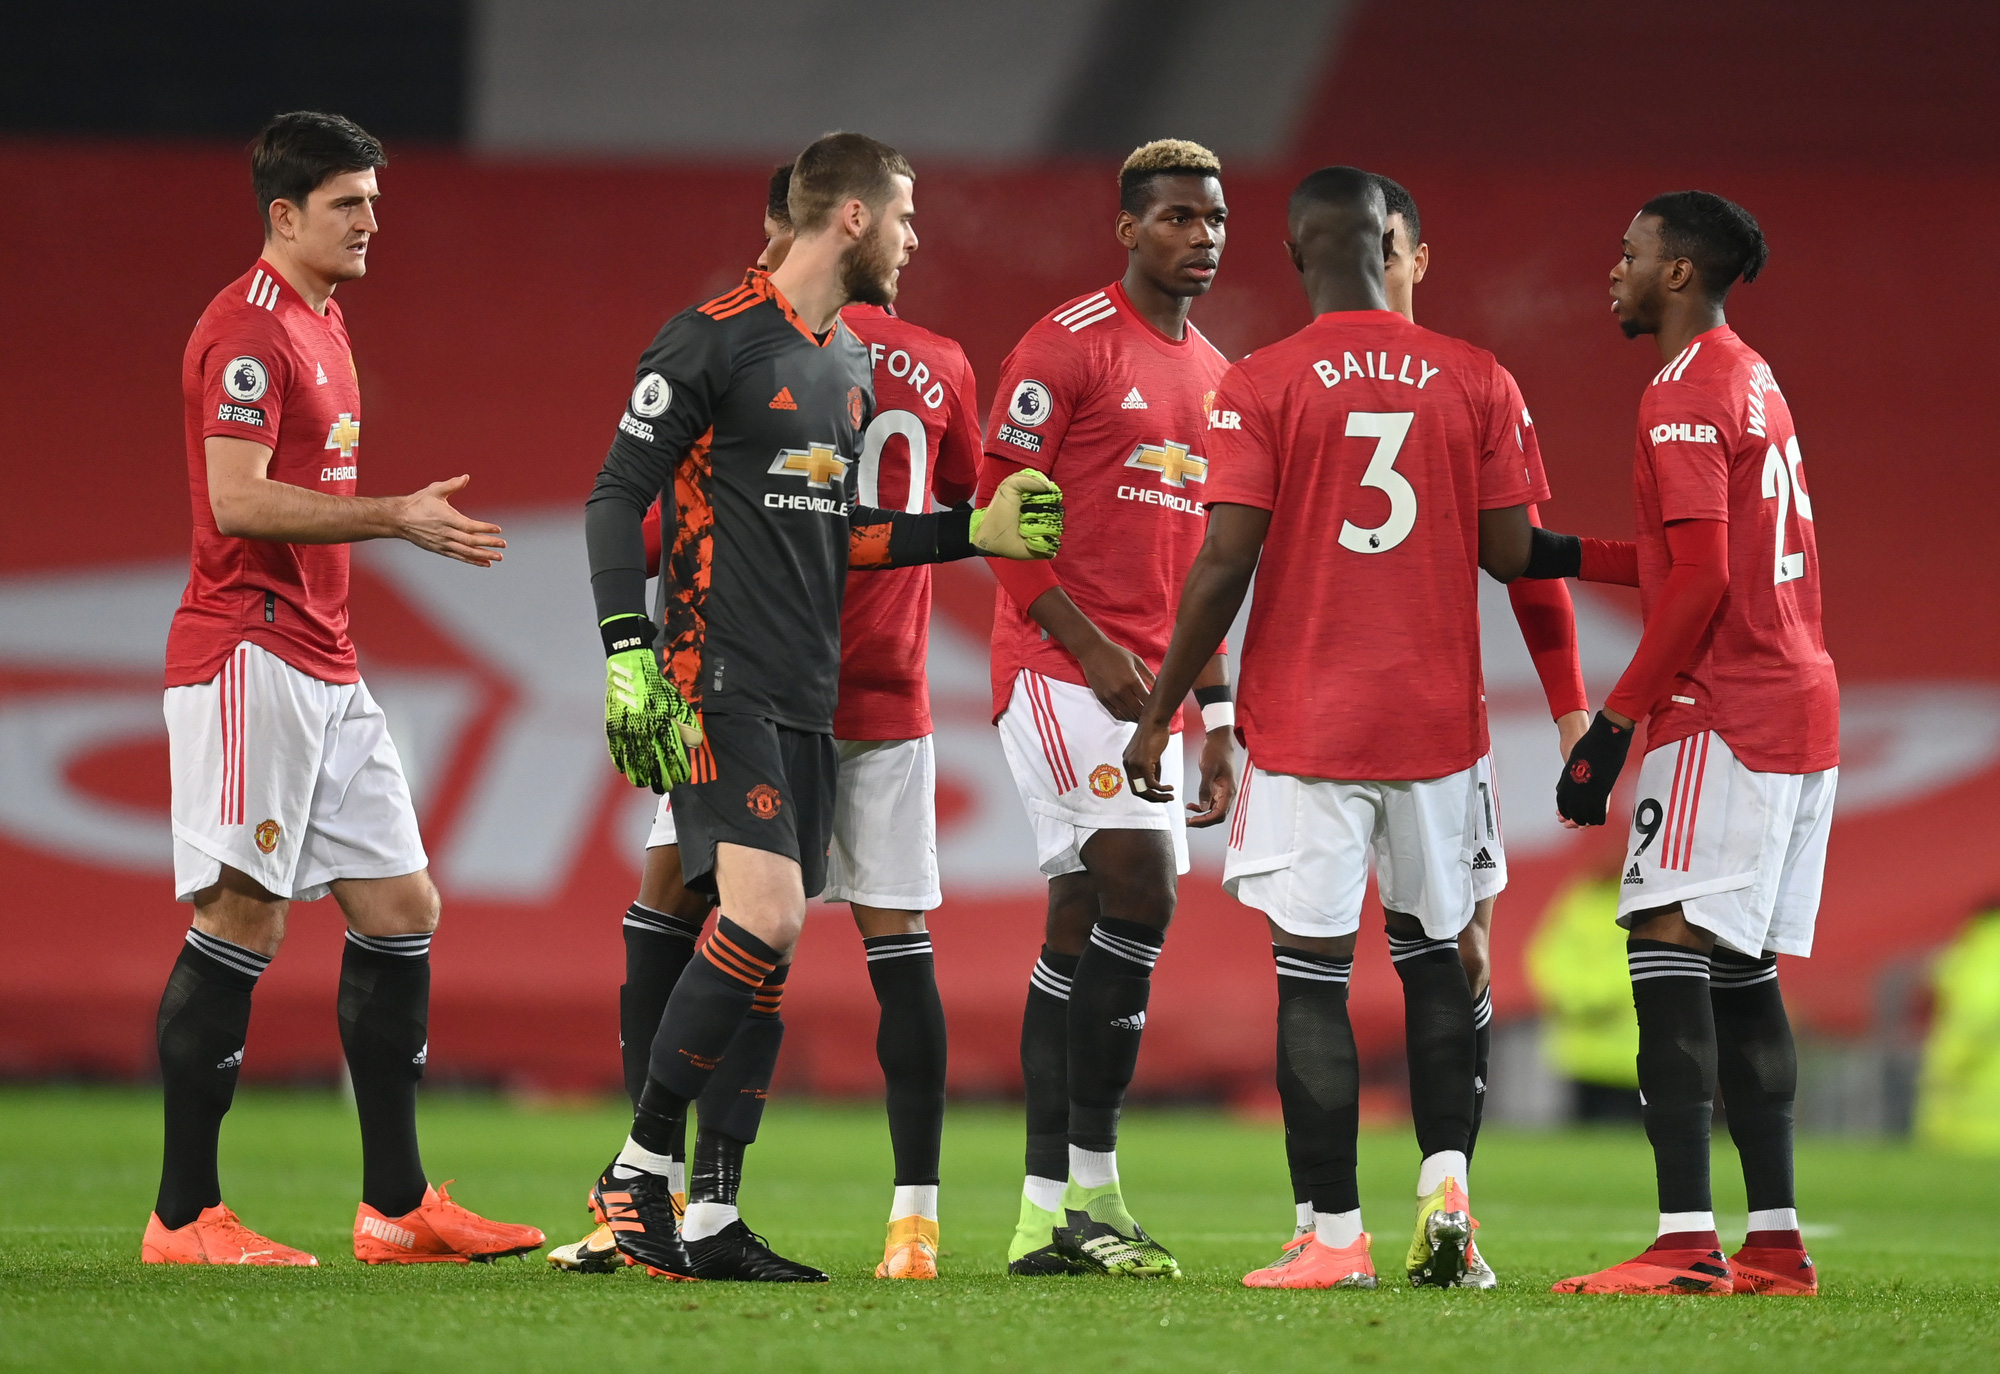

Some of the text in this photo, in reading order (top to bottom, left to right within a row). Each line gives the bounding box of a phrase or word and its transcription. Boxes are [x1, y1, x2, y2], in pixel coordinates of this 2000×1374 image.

[870, 342, 944, 409] FORD
[1312, 351, 1440, 390] BAILLY
[219, 403, 260, 418] No room
[1120, 400, 1148, 410] adidas
[217, 411, 263, 427] for racism
[630, 417, 653, 434] room
[1207, 409, 1242, 431] HLER
[625, 425, 655, 443] racism
[1012, 428, 1039, 444] room
[1649, 423, 1718, 447] KOHLER
[1009, 436, 1041, 453] racism
[1337, 411, 1418, 554] 3
[764, 493, 848, 517] CHEVROLE
[1117, 485, 1205, 517] CHEVROLE
[629, 637, 642, 647] DE
[1478, 782, 1494, 841] 1
[1634, 797, 1664, 857] 9
[1110, 1020, 1145, 1031] adid
[216, 1059, 242, 1069] adid
[361, 1216, 416, 1249] PUMA
[1736, 1271, 1775, 1286] NEMESIS
